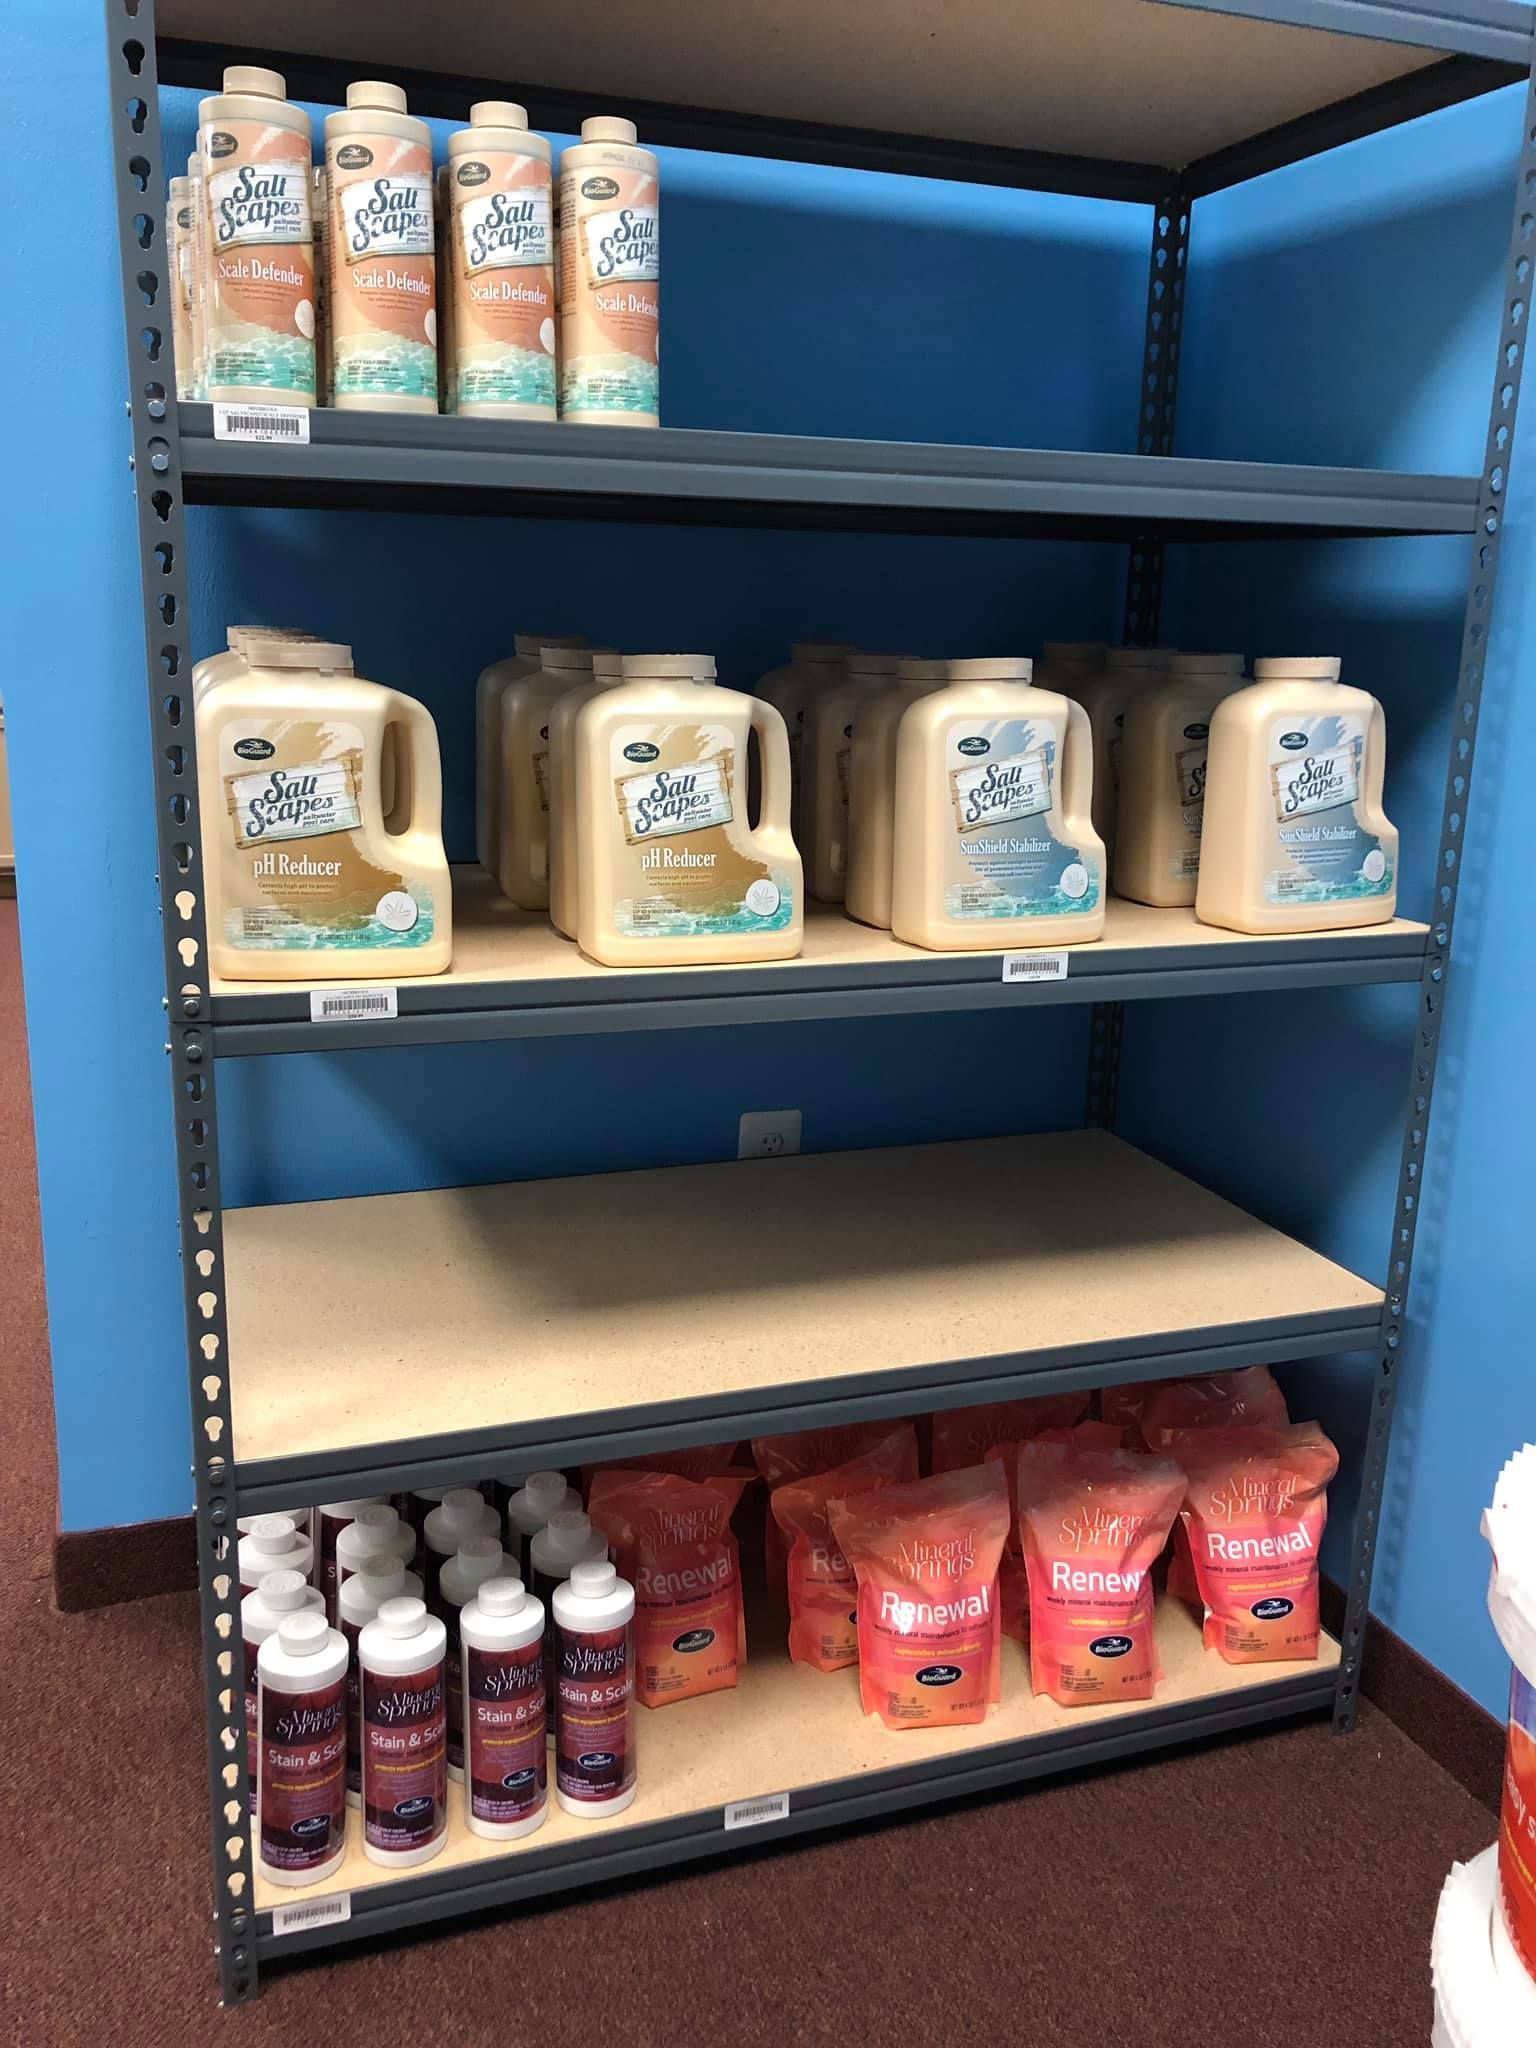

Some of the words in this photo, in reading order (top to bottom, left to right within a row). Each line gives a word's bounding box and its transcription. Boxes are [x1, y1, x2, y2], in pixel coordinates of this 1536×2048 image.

[233, 166, 287, 204] Salt
[368, 178, 418, 215] Salt
[219, 197, 300, 241] Scapes
[485, 193, 534, 229] Salt
[352, 208, 428, 251] Scapes
[470, 223, 545, 266] Scapes
[597, 236, 659, 277] Scape
[219, 258, 249, 279] Scale
[251, 259, 304, 286] Defender
[352, 268, 384, 288] Scale
[386, 269, 431, 296] Defender
[470, 281, 500, 301] Scale
[502, 281, 547, 305] Defender
[595, 292, 626, 312] Scale
[628, 293, 659, 318] Defend
[237, 746, 272, 756] BioGuard
[626, 750, 658, 758] BioGuard
[980, 764, 1021, 793] Salt
[1299, 757, 1334, 785] Salt
[263, 771, 318, 804] Salt
[650, 771, 697, 803] Salt
[1285, 775, 1344, 813] Scapes
[246, 797, 334, 837] Scapes
[635, 793, 711, 834] Scapes
[966, 783, 1034, 823] Scapes
[302, 819, 319, 828] pool
[320, 817, 335, 825] care
[1279, 827, 1320, 843] SunShield
[1321, 826, 1357, 841] Stabilizer
[642, 847, 661, 872] pH
[663, 847, 717, 868] Reducer
[960, 839, 1008, 855] SunShield
[1009, 837, 1052, 854] Stabilizer
[253, 853, 275, 879] pH
[279, 853, 342, 876] Reducer
[1229, 1475, 1299, 1497] Mineral
[1081, 1506, 1147, 1530] Miner
[1209, 1490, 1294, 1523] Springs
[899, 1528, 977, 1562] Mineral
[1059, 1517, 1138, 1552] Sprin
[1206, 1521, 1313, 1560] Renewal
[635, 1549, 733, 1595] Renewal
[1052, 1561, 1146, 1593] Renew
[880, 1585, 990, 1626] Renewal
[1256, 1605, 1289, 1616] BioGuard
[678, 1634, 711, 1650] BioGuard
[1095, 1644, 1128, 1653] BioGuard
[563, 1652, 625, 1675] Springs
[921, 1672, 957, 1682] BioGuard
[559, 1681, 588, 1703] Stain
[590, 1689, 603, 1703] &
[477, 1707, 512, 1723] Stain
[515, 1706, 527, 1720] &
[529, 1695, 546, 1715] Sca
[371, 1731, 406, 1749] Stain
[408, 1732, 421, 1747] &
[424, 1722, 446, 1743] Sca
[269, 1750, 304, 1767] Stain
[307, 1751, 321, 1765] &
[323, 1743, 346, 1760] Sca
[583, 1758, 612, 1766] BioGuard
